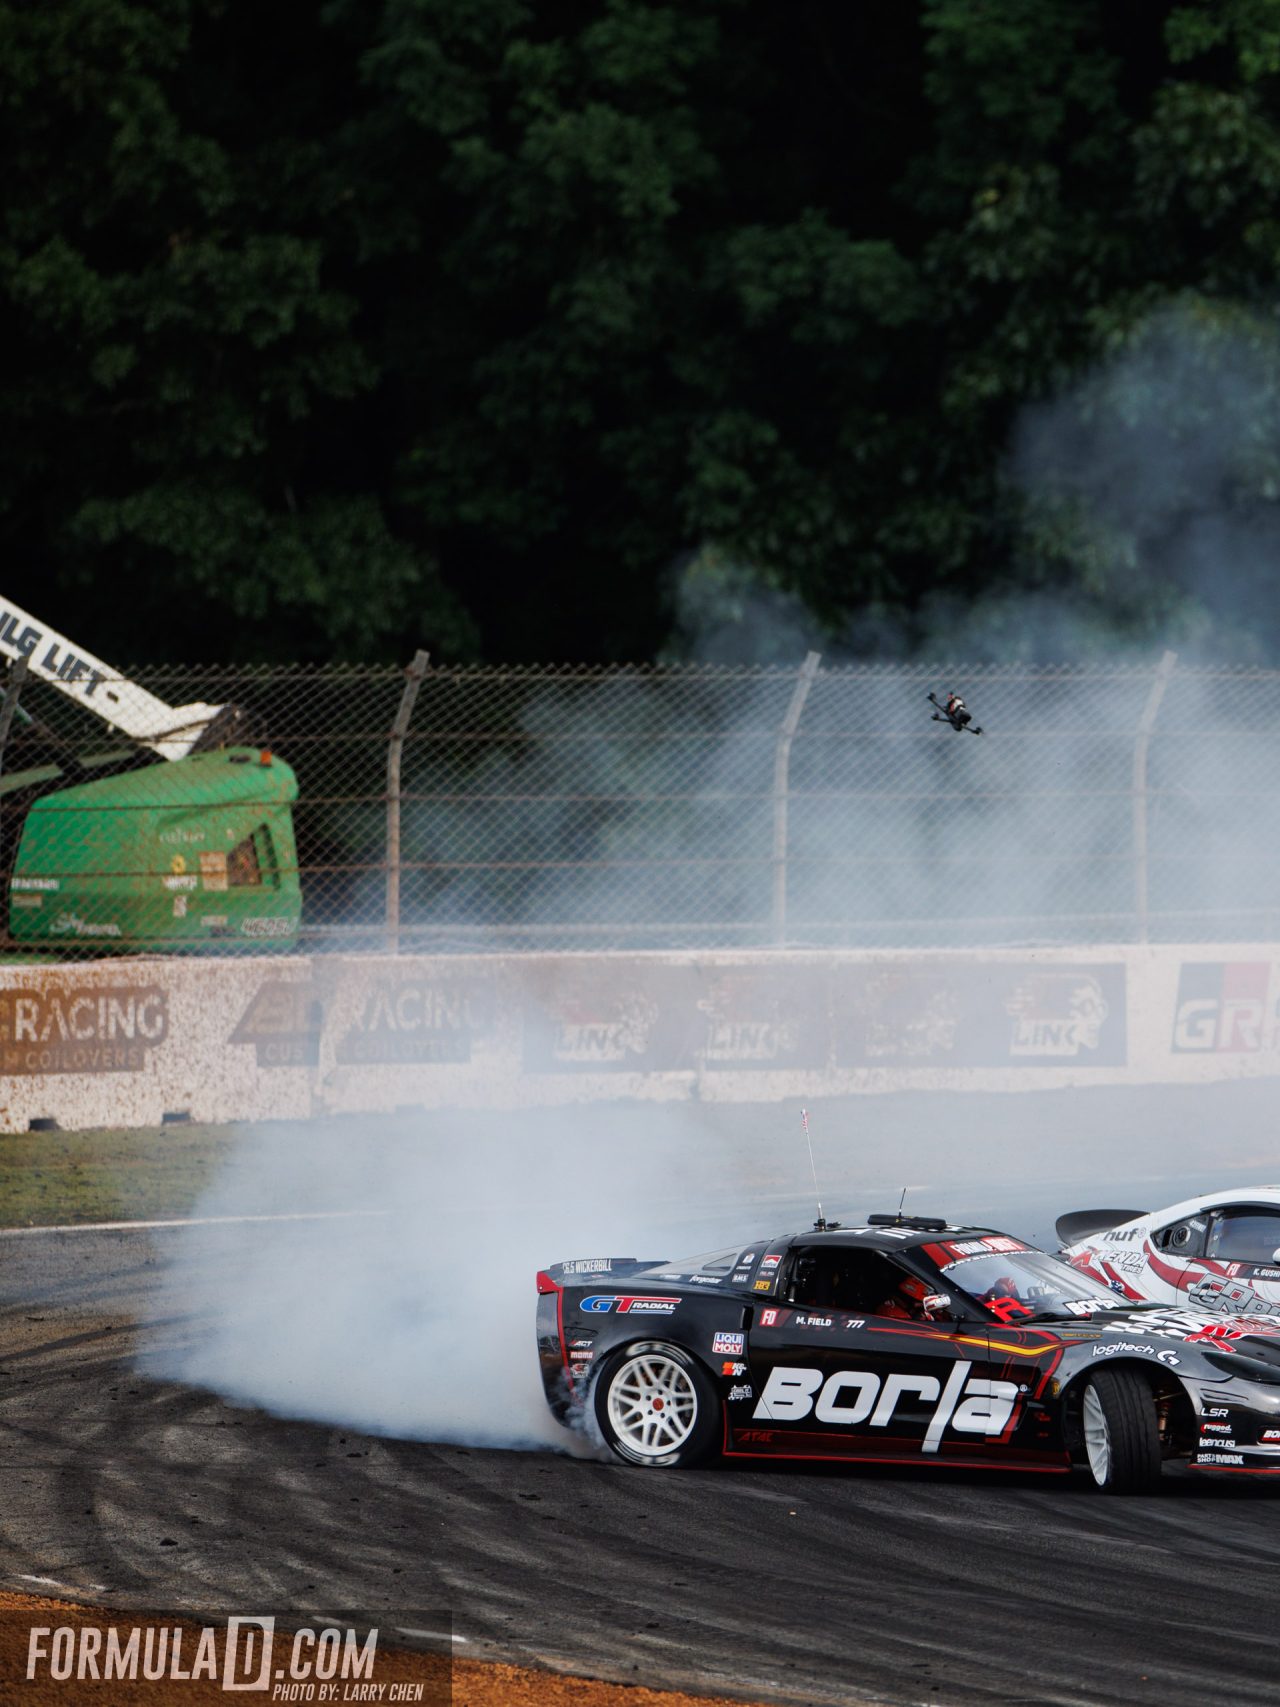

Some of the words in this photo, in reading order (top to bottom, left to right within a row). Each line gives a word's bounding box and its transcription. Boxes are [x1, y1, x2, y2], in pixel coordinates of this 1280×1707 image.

[14, 993, 164, 1042] RACING
[1174, 998, 1263, 1049] GR
[1013, 1022, 1079, 1047] LINK
[25, 1046, 140, 1070] COILOVERS
[1121, 1263, 1144, 1275] TIRES
[632, 1301, 676, 1310] RADIAL
[796, 1316, 806, 1325] M.
[808, 1318, 832, 1327] FIELD
[846, 1320, 866, 1329] 777
[716, 1334, 742, 1344] LIQUI
[714, 1343, 742, 1353] MOLY
[1092, 1342, 1155, 1357] logitech
[1201, 1407, 1229, 1417] LSR
